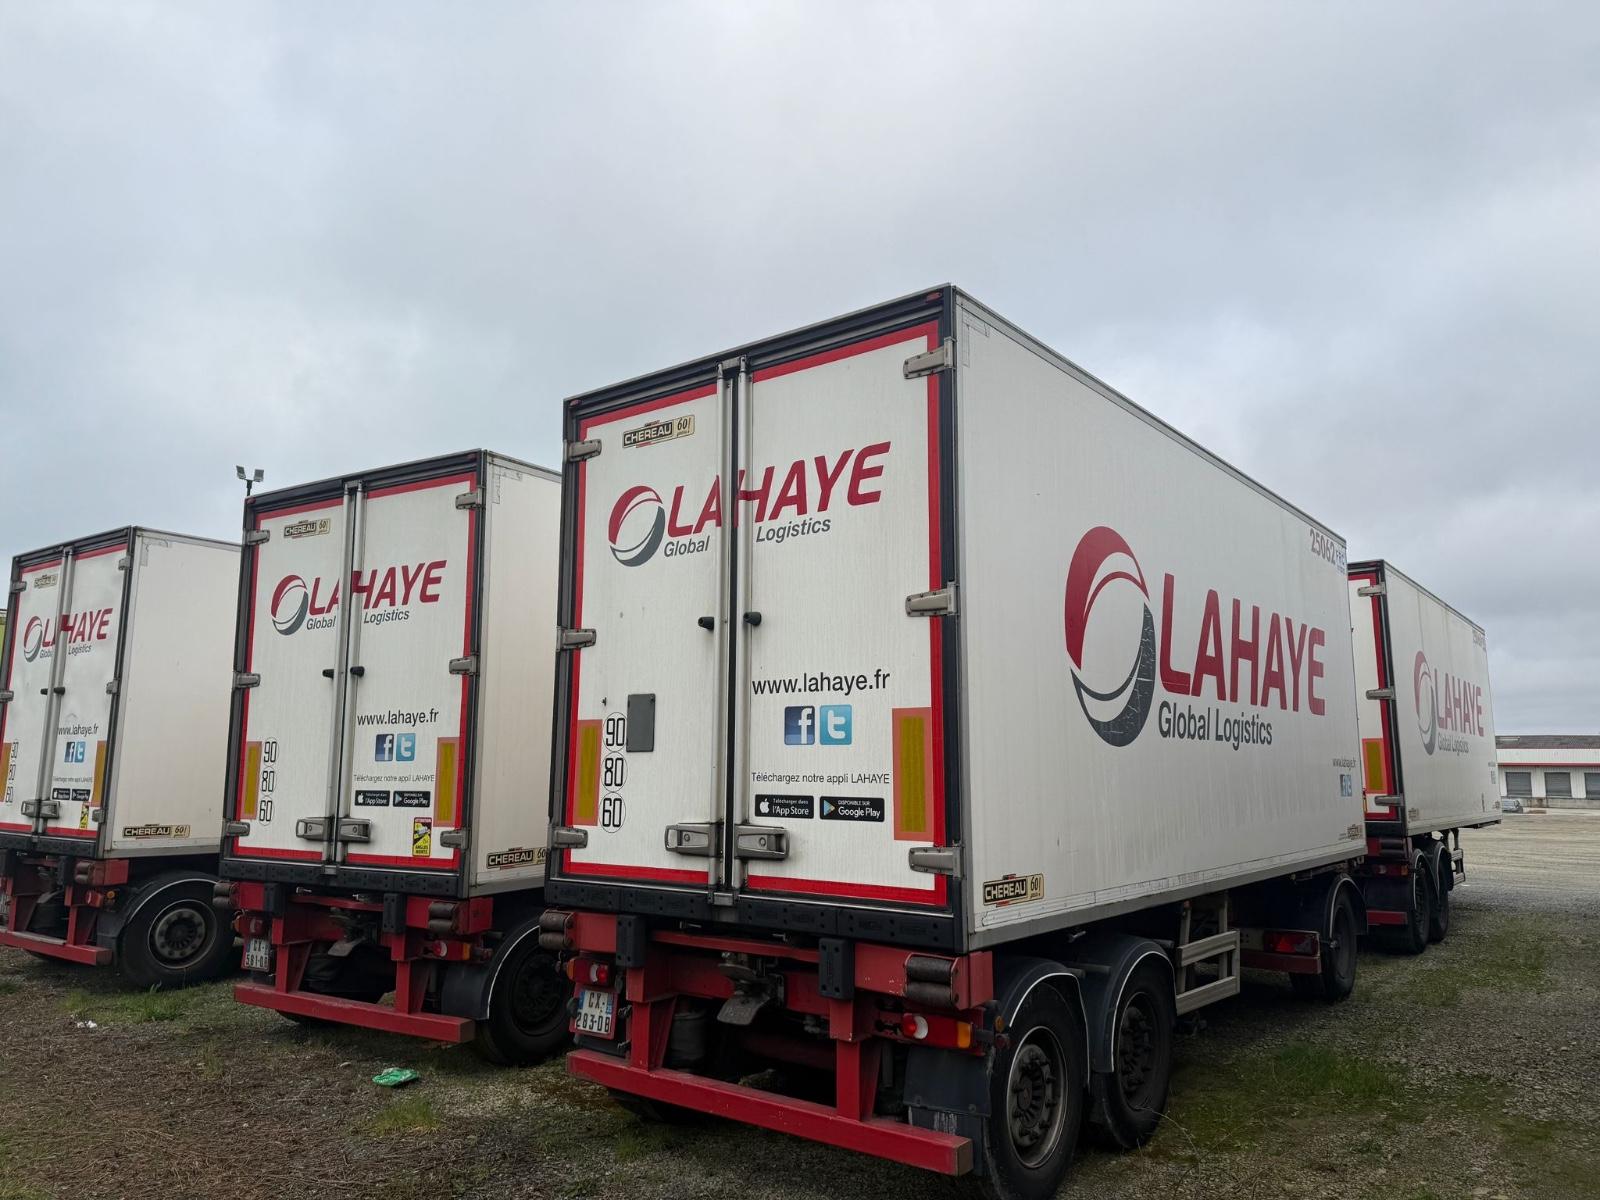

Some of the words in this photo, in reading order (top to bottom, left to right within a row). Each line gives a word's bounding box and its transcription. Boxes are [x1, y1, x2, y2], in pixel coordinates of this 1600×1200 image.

[624, 423, 672, 445] CHEREAU
[667, 441, 891, 538] LAHAYE
[285, 522, 316, 536] CHEREAU
[664, 536, 710, 557] Global
[756, 518, 831, 543] Logistics
[1309, 528, 1336, 566] 25062
[309, 559, 447, 616] LAHAYE
[306, 615, 336, 630] Global
[363, 608, 410, 625] Logistics
[68, 644, 92, 656] Logistics
[1159, 572, 1325, 717] LAHAYE
[752, 668, 890, 696] www.lahaye.fr
[1434, 668, 1484, 737] LAHAYE
[357, 708, 439, 727] www.lahaye.fr
[1159, 700, 1211, 741] Global
[1215, 708, 1272, 751] Logistics
[57, 723, 99, 737] www.lahaye.fr
[606, 718, 626, 746] 90
[264, 741, 277, 762] 90
[262, 771, 275, 792] 80
[413, 774, 435, 782] LAHAYE
[604, 757, 624, 787] 80
[752, 772, 800, 785] Téléchargez
[802, 774, 824, 783] notre
[827, 774, 849, 785] appli
[851, 773, 890, 784] LAHAYE
[259, 800, 272, 821] 60
[404, 797, 418, 806] Google
[791, 806, 809, 816] Store
[602, 798, 622, 827] 60
[838, 807, 864, 819] Google
[865, 807, 881, 819] Play
[124, 827, 170, 836] CHEREAU
[488, 851, 533, 866] CHEREAU
[985, 880, 1026, 900] CHEREAU
